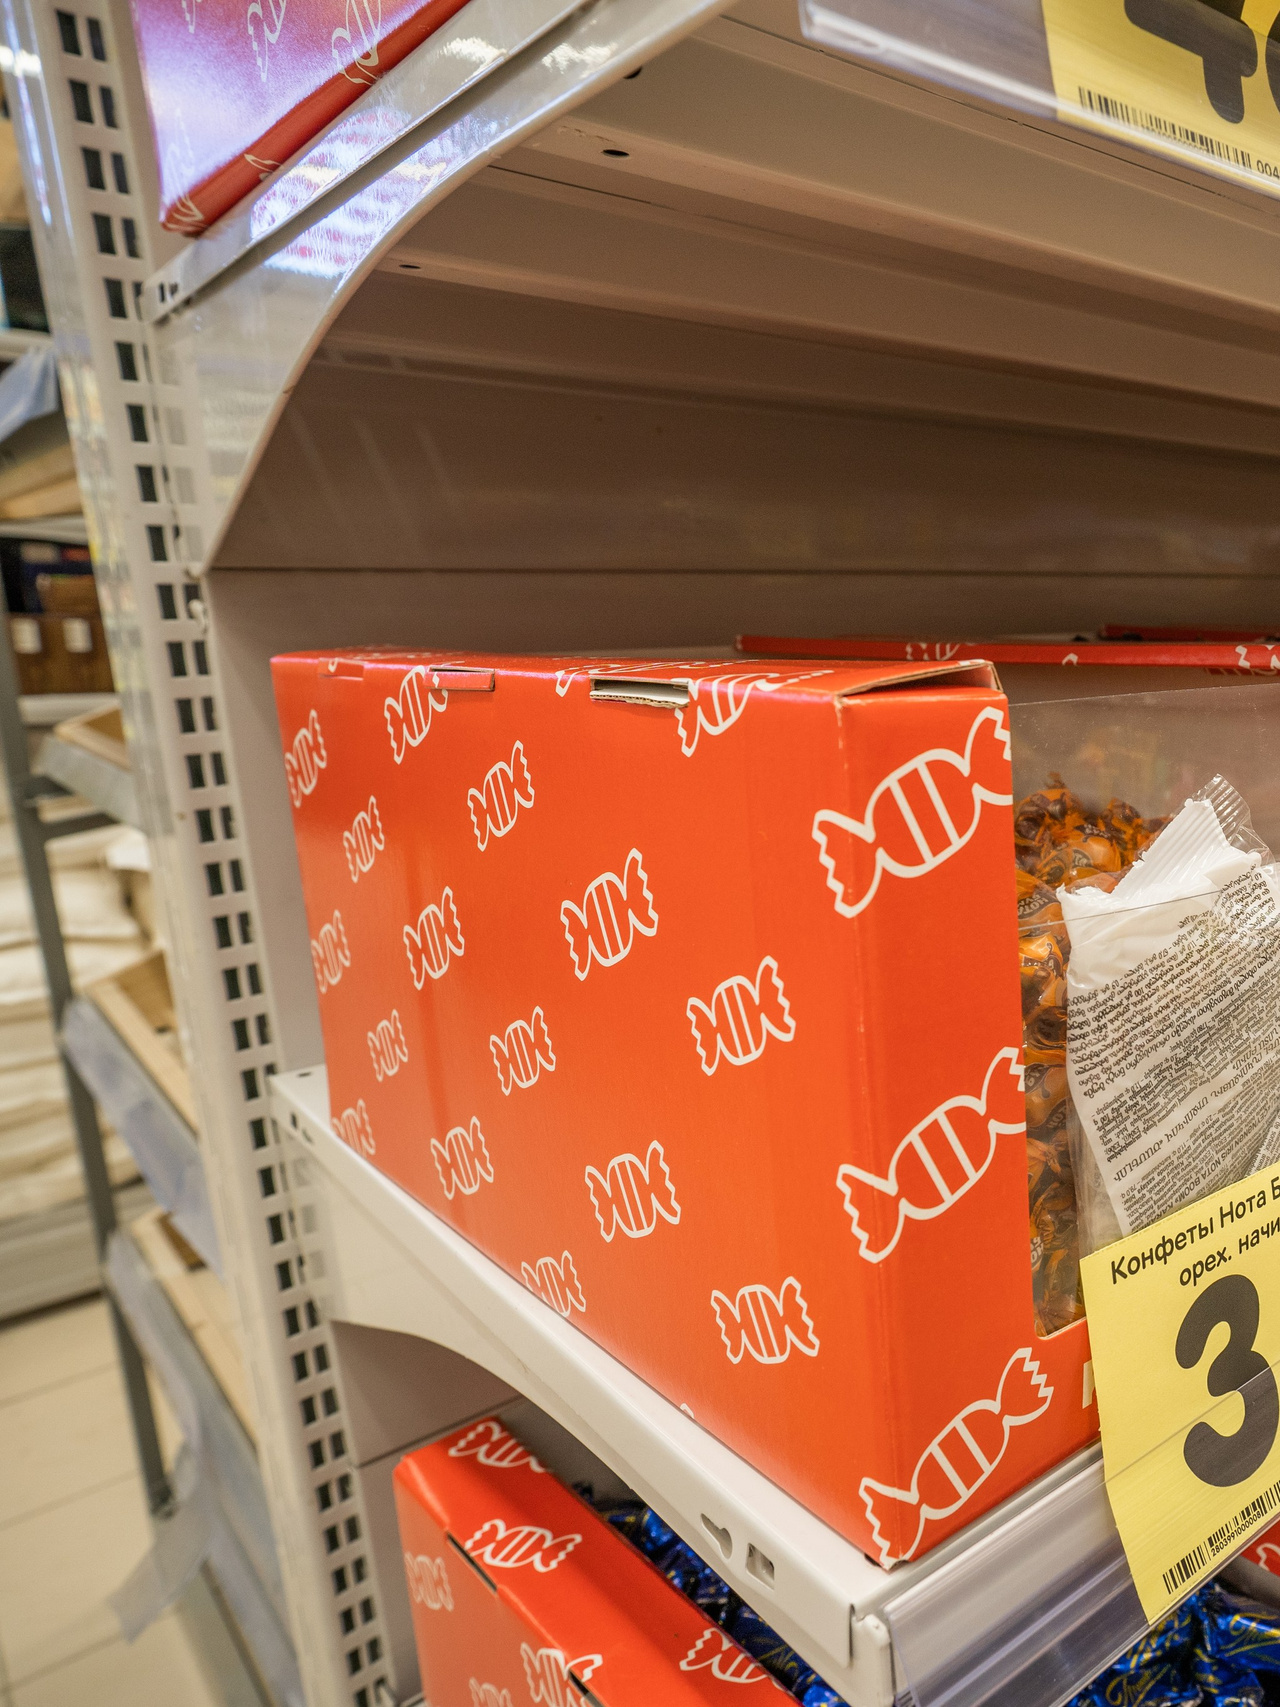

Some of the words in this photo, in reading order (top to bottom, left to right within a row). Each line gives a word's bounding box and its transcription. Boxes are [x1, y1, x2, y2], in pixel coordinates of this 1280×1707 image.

[1201, 1156, 1220, 1178] NOTA
[1173, 1176, 1200, 1203] BOOM»
[1110, 1217, 1214, 1285] Конфеты
[1218, 1191, 1268, 1233] Нота
[1179, 1247, 1232, 1288] орех.
